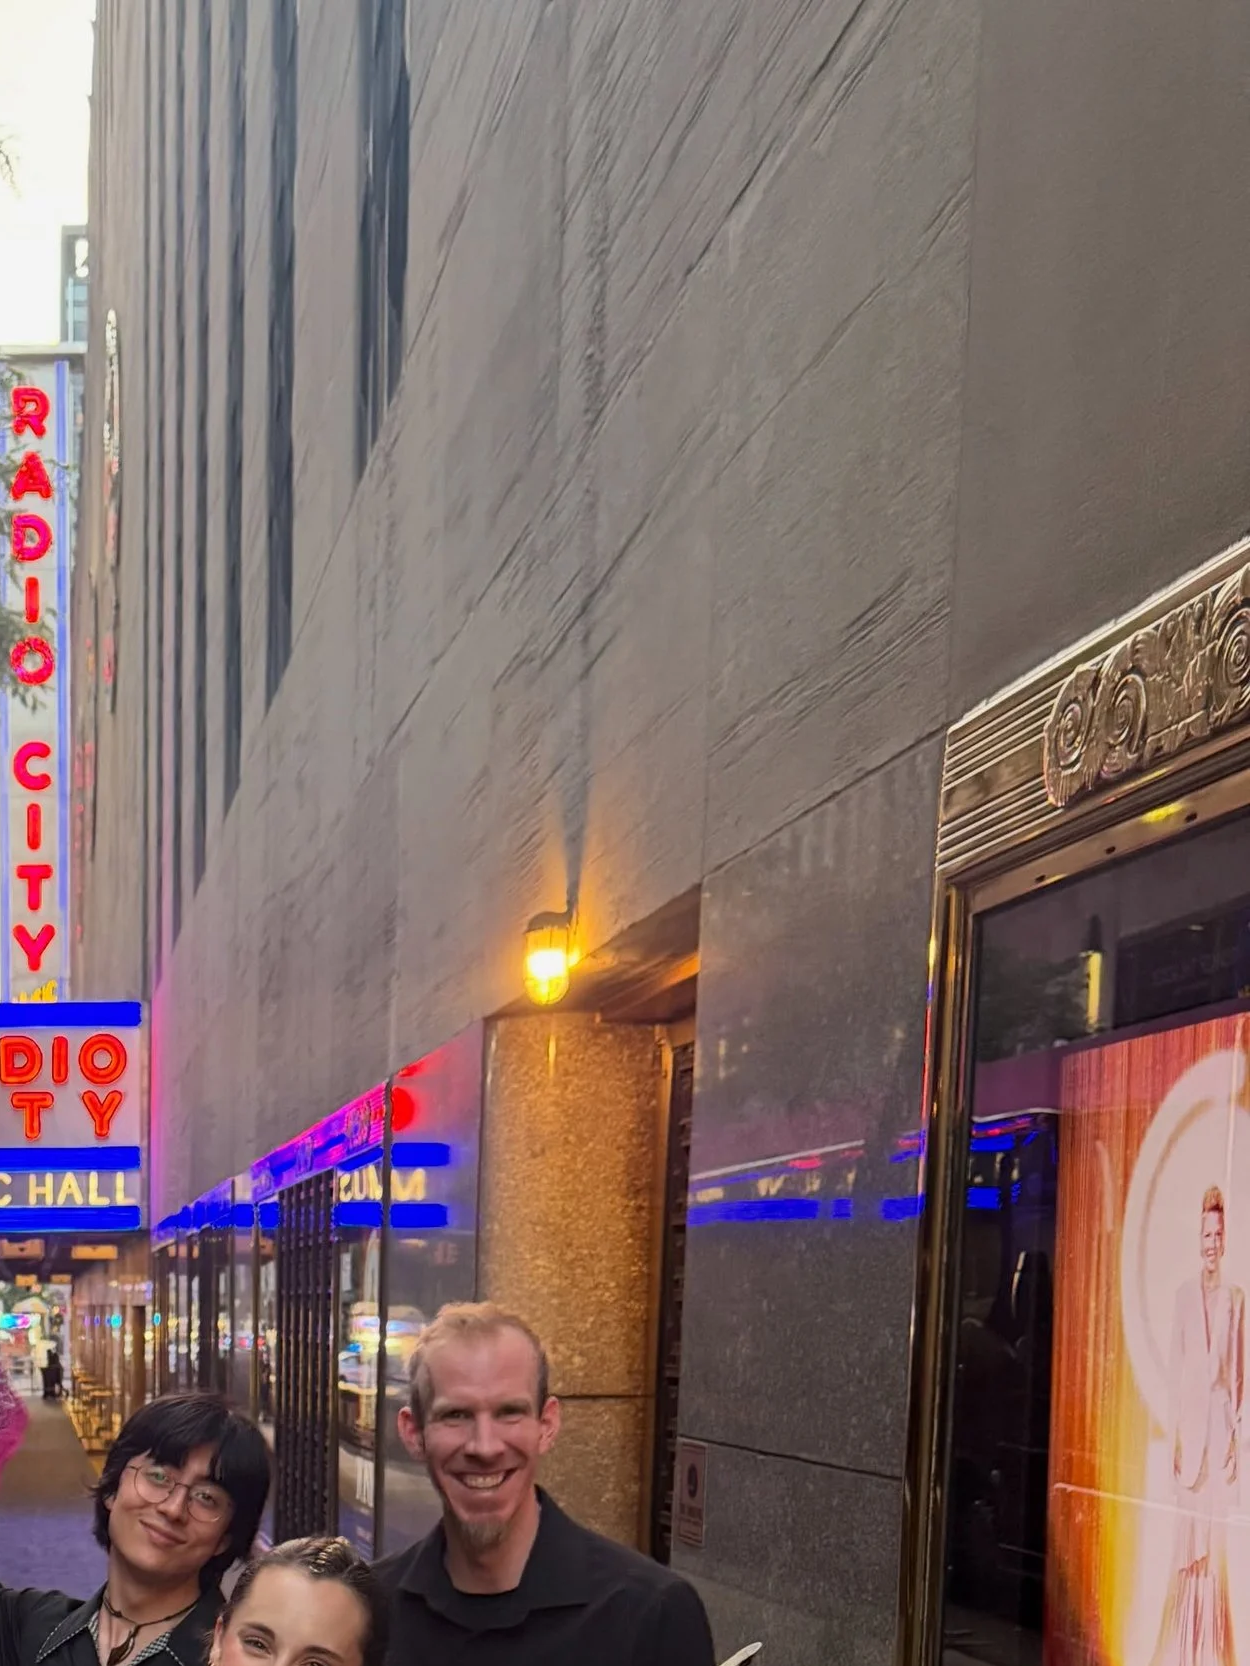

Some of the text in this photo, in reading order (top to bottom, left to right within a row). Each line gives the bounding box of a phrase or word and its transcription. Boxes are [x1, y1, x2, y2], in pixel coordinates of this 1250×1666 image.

[11, 385, 55, 686] RADIO
[13, 741, 55, 972] CITY
[28, 1172, 137, 1206] HALL
